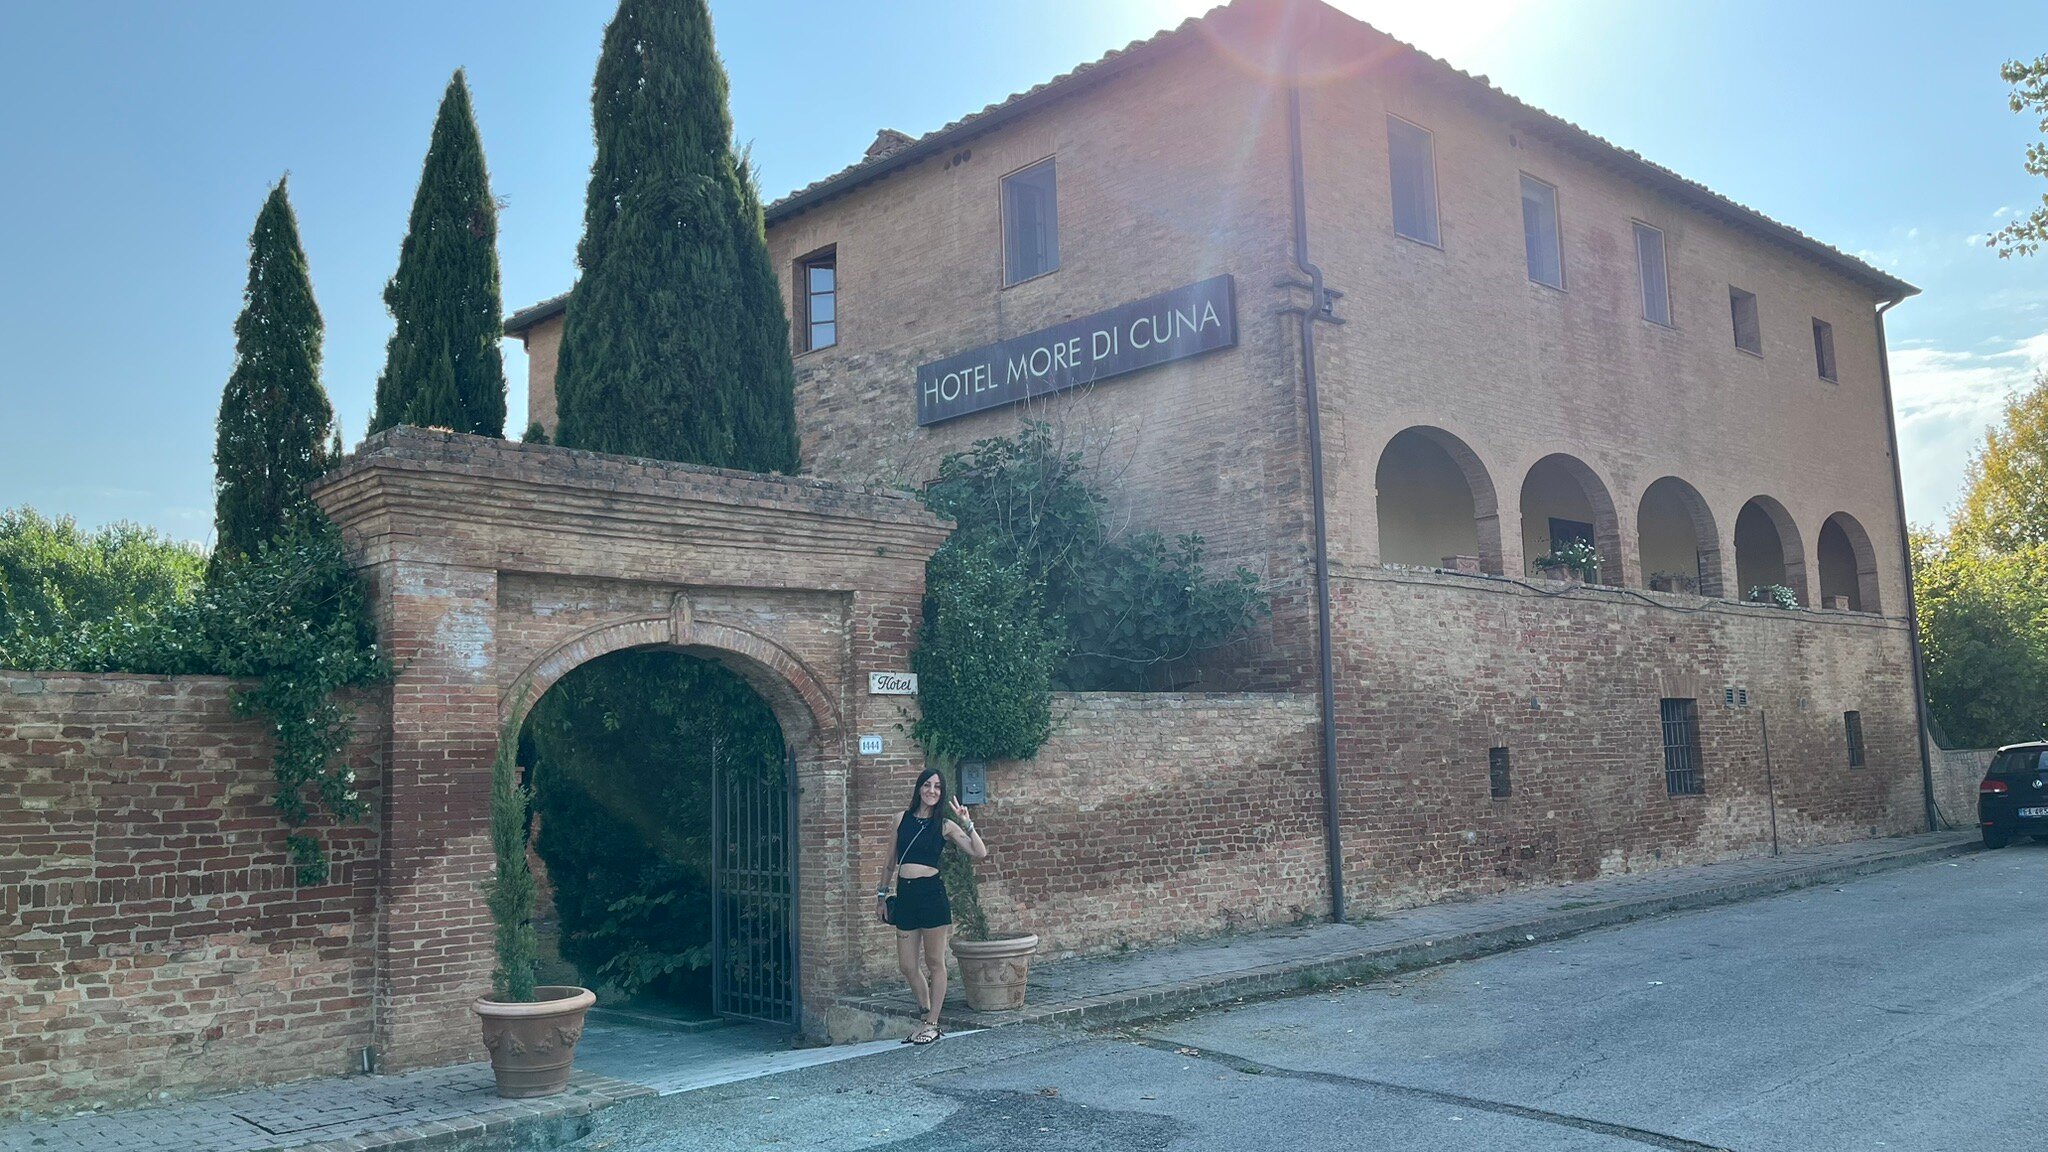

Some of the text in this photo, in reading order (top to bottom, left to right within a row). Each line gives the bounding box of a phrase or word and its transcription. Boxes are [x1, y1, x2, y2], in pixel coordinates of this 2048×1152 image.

[924, 300, 1221, 407] HOTEL MORE DI CUNA
[877, 675, 912, 691] Hotel
[862, 741, 879, 750] 1444
